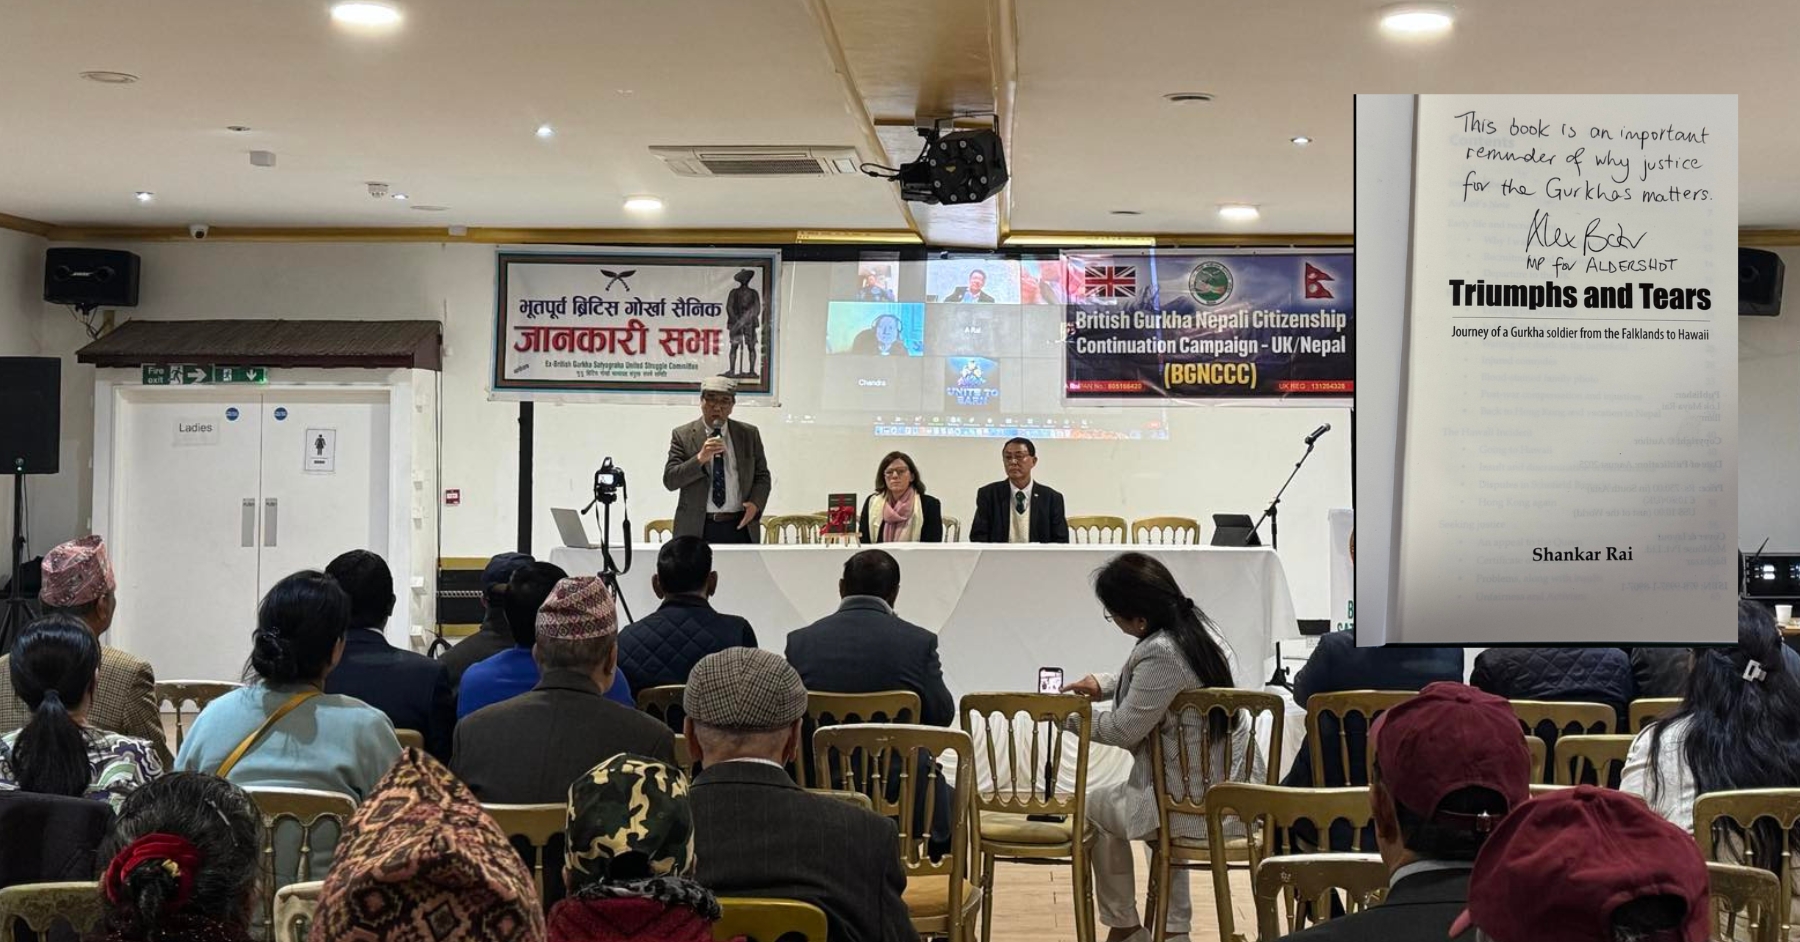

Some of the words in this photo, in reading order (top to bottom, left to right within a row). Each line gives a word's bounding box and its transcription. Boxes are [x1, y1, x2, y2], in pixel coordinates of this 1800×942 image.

[1454, 111, 1497, 135] This
[1509, 118, 1550, 137] book
[1561, 122, 1577, 138] is
[1590, 126, 1614, 141] an
[1620, 125, 1710, 150] important
[1466, 147, 1557, 165] reminder
[1566, 147, 1586, 176] of
[1595, 150, 1630, 183] why
[1640, 154, 1703, 181] justice
[1463, 171, 1490, 202] for
[1501, 178, 1537, 197] the
[1546, 176, 1632, 202] Gurkhas
[1642, 185, 1713, 203] matters.
[1526, 255, 1546, 271] MP
[1552, 257, 1577, 278] for
[1586, 256, 1678, 274] ALDERSHOT
[1449, 279, 1578, 310] Triumphs
[1583, 283, 1634, 309] and
[1639, 283, 1712, 311] Tears
[519, 296, 567, 319] भूतपूर्व
[573, 296, 620, 318] ब्रिटिस
[624, 297, 666, 317] गोर्खा
[671, 297, 723, 318] सैनिक
[1076, 310, 1129, 330] British
[1133, 310, 1191, 330] Gurkha
[1195, 310, 1249, 333] Nepali
[1252, 309, 1346, 333] Citizenship
[513, 318, 650, 355] जानकारी
[658, 327, 723, 357] सभा
[1451, 325, 1489, 341] Journey
[1490, 326, 1502, 338] of
[1502, 328, 1509, 338] a
[1510, 326, 1545, 338] Gurkha
[1546, 327, 1578, 339] soldier
[1579, 327, 1602, 339] from
[1603, 327, 1620, 339] the
[1621, 327, 1665, 340] Falklands
[1666, 329, 1676, 340] to
[1678, 328, 1709, 340] Hawaii
[1076, 336, 1177, 354] Continuation
[1179, 336, 1259, 357] Campaign
[1271, 335, 1346, 357] UK/Nepal
[147, 366, 165, 375] Fire
[572, 360, 592, 369] Gurkha
[668, 362, 699, 370] Committee
[1164, 362, 1257, 388] (BGNCCC)
[147, 376, 164, 384] exit
[178, 422, 213, 433] Ladies
[1532, 546, 1601, 562] Shankar
[1606, 546, 1633, 562] Rai
